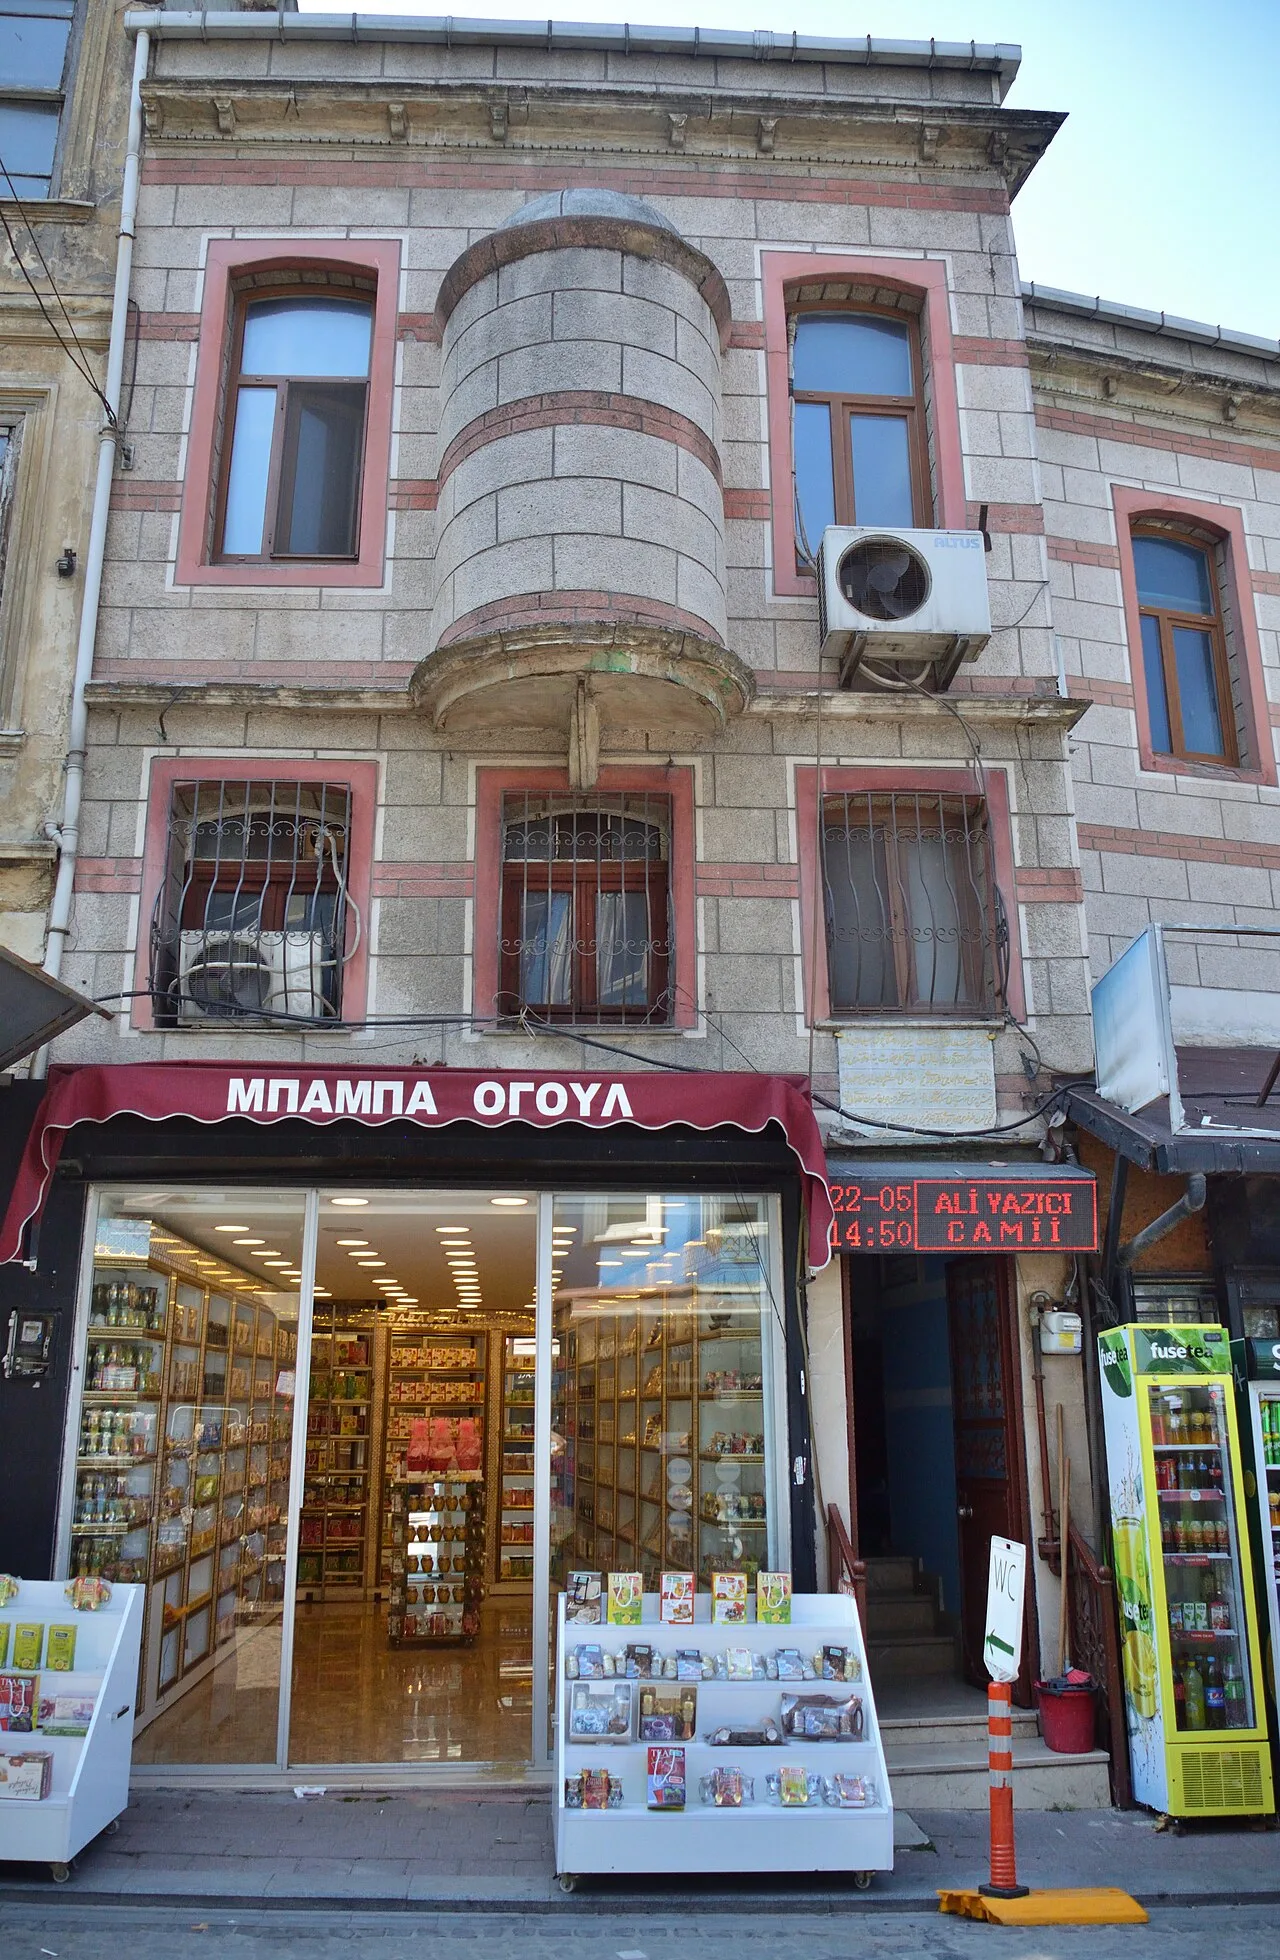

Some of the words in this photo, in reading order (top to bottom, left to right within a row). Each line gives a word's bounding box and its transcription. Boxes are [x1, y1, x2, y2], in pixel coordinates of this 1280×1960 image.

[934, 538, 980, 549] ALTUS
[226, 1078, 438, 1115] ΜΠΑΜΠΑ
[473, 1080, 635, 1119] ΟΓΟΥΛ
[935, 1188, 977, 1214] ALİ
[831, 1220, 912, 1247] 14:50
[1150, 1341, 1214, 1359] fusetea
[993, 1554, 1017, 1602] WC
